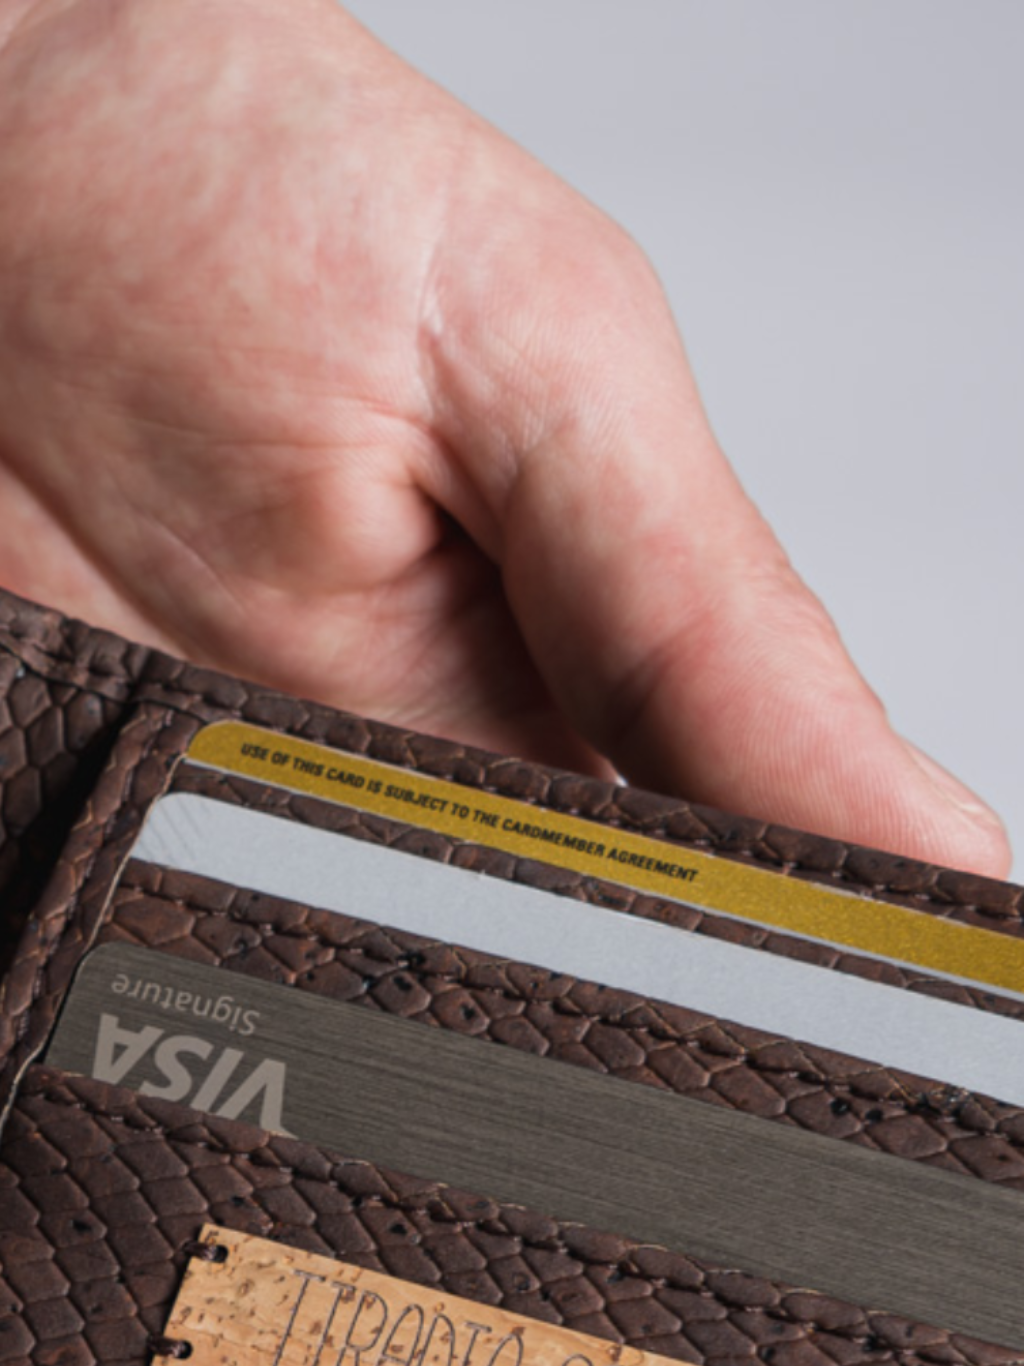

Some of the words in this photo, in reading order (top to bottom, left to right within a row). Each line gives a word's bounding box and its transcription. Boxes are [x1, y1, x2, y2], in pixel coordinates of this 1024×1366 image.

[240, 742, 267, 761] USE
[270, 749, 290, 766] OF
[292, 757, 324, 777] THIS
[326, 767, 366, 789] CARD
[367, 778, 383, 794] IS
[384, 784, 449, 813] SUBJECT
[451, 802, 470, 820] TO
[473, 809, 500, 828] THE
[502, 818, 607, 857] CARDMEMBER
[607, 847, 699, 883] AGREEMENT
[110, 973, 260, 1036] Signature
[91, 1012, 299, 1140] VISA
